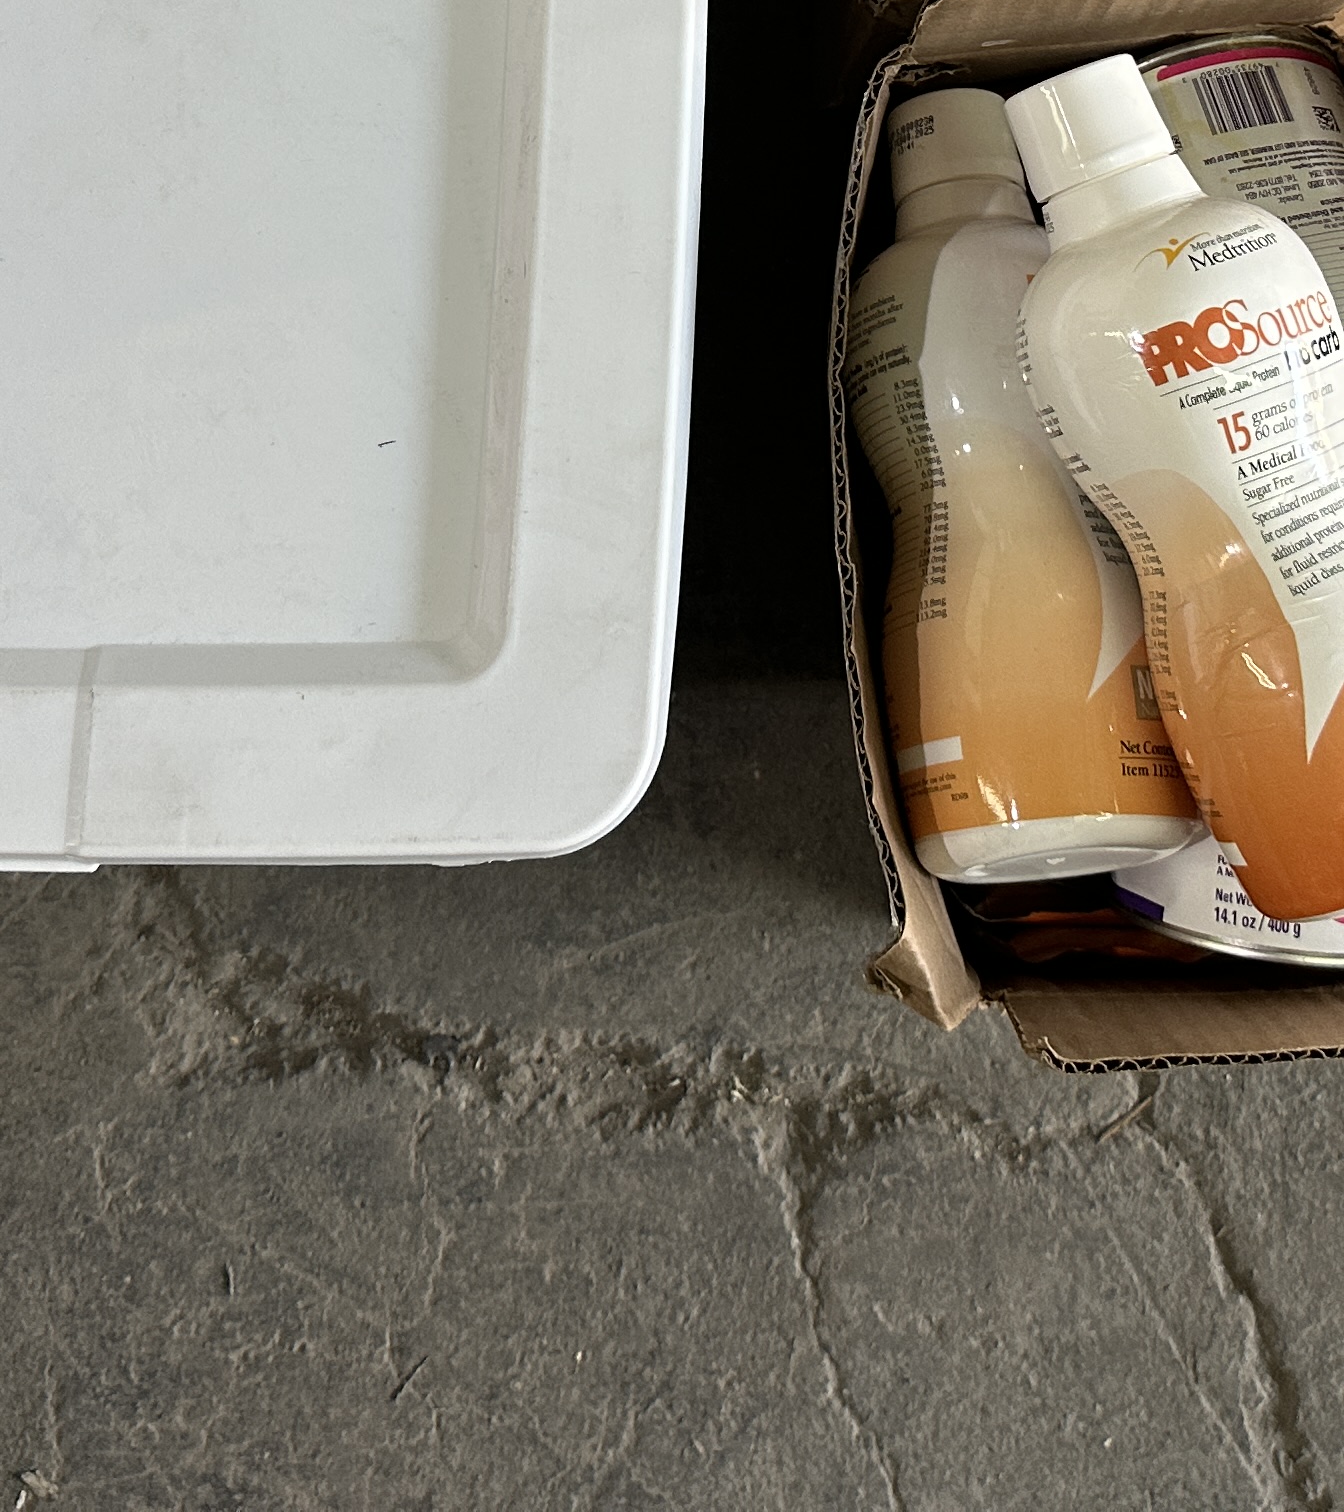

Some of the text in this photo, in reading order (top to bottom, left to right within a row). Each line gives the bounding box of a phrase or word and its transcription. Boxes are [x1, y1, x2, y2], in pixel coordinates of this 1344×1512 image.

[1187, 231, 1277, 271] Medtrition
[1307, 324, 1342, 360] carb
[1250, 401, 1287, 424] grams
[1216, 410, 1254, 455] 15
[1254, 424, 1270, 441] 60
[1235, 446, 1296, 480] A Medical
[1242, 473, 1295, 501] Sugar Free
[1275, 510, 1319, 539] conditions
[1270, 531, 1314, 562] additional
[1279, 564, 1293, 580] for
[1292, 552, 1318, 573] fluid
[1288, 572, 1320, 596] liquid
[1120, 740, 1141, 753] Net
[1121, 763, 1148, 775] Item
[1214, 887, 1233, 903] Net
[1213, 906, 1300, 937] 14.1 oz / 400 g
